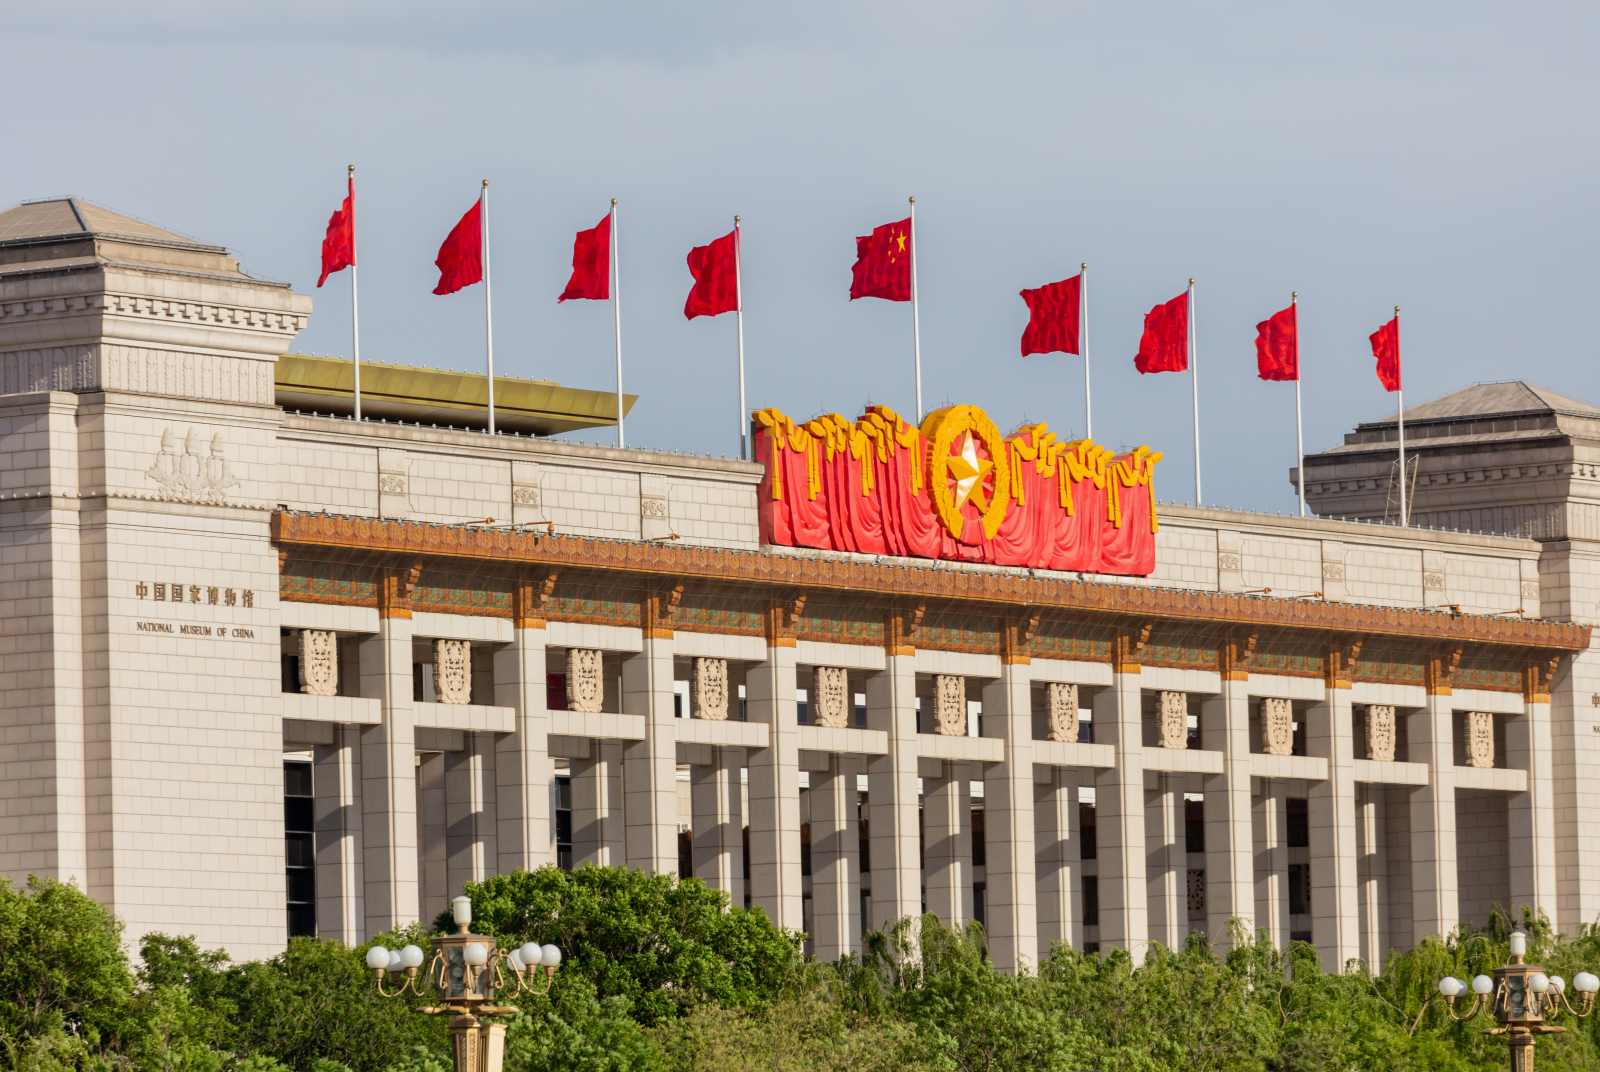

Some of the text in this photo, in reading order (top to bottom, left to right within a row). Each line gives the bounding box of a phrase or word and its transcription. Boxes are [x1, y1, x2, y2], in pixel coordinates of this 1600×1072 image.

[136, 581, 254, 608] 中国国家博物馆
[136, 622, 254, 639] NATIONAL MUSEUM OF CHINA
